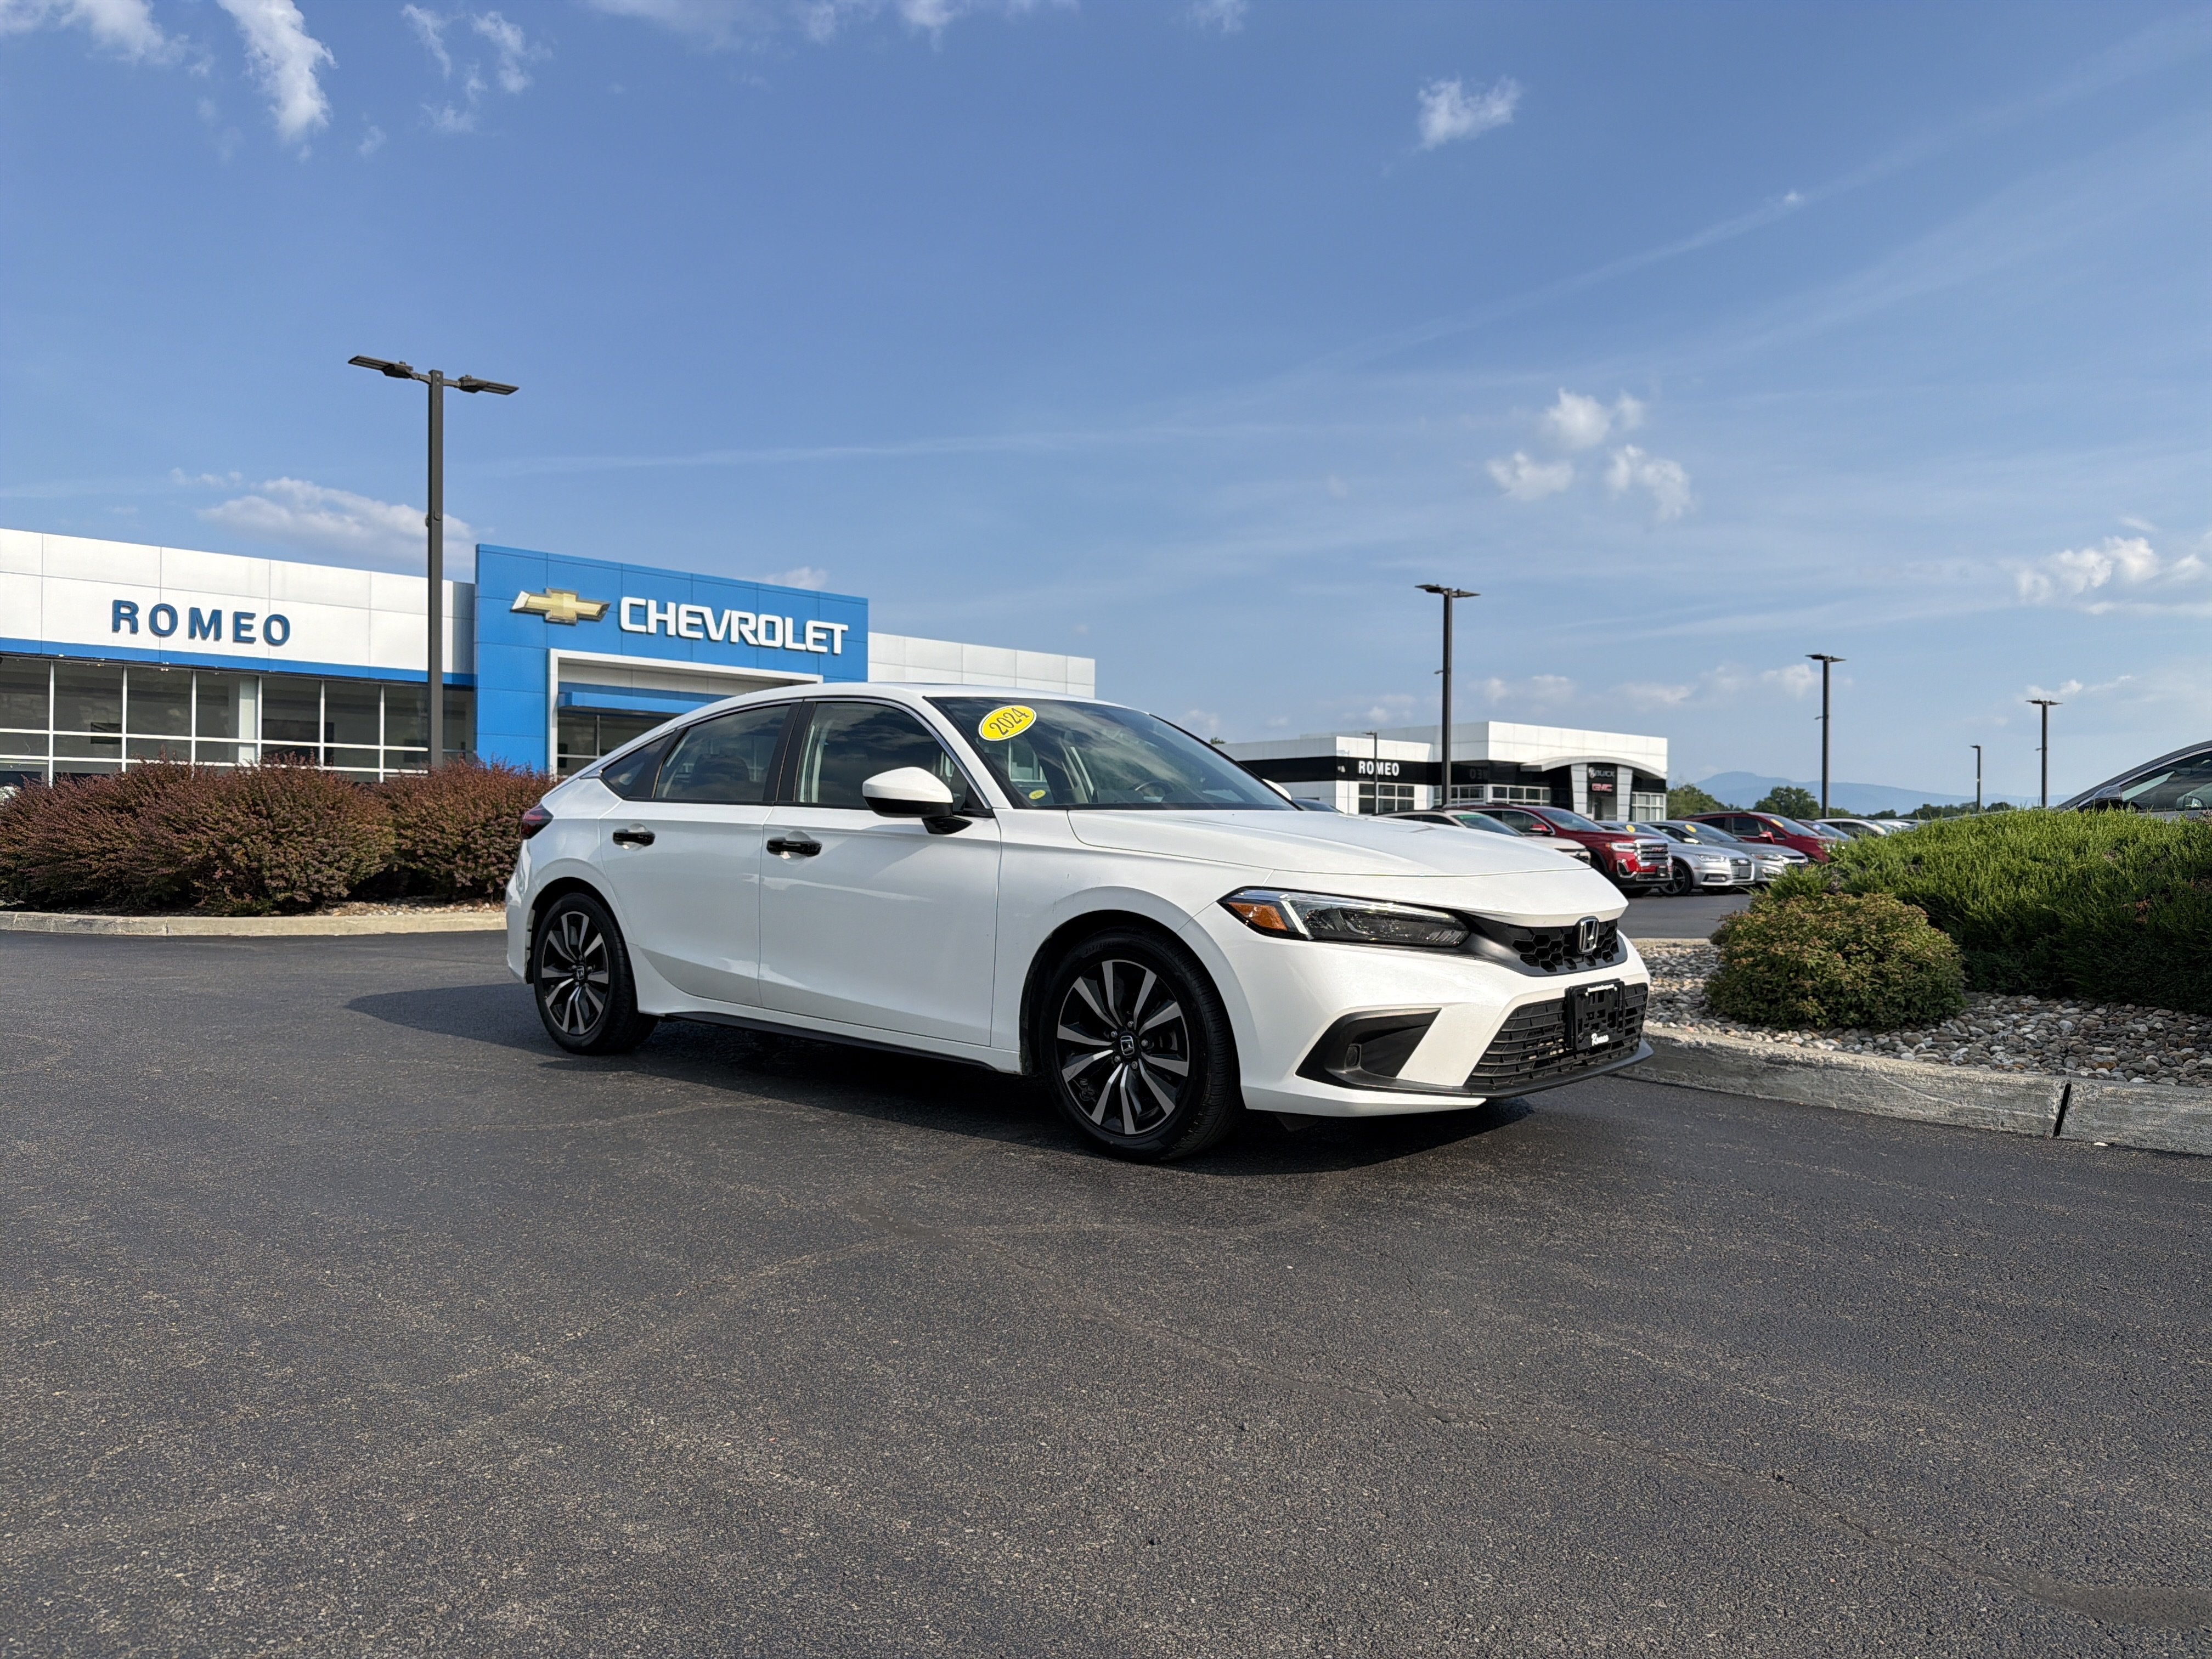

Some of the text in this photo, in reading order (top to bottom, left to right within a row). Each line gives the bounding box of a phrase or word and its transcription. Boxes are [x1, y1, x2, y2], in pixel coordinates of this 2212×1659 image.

[112, 599, 291, 647] ROMEO
[620, 596, 849, 654] CHEVROLET
[989, 708, 1030, 736] 2024
[1358, 760, 1400, 776] ROMEO
